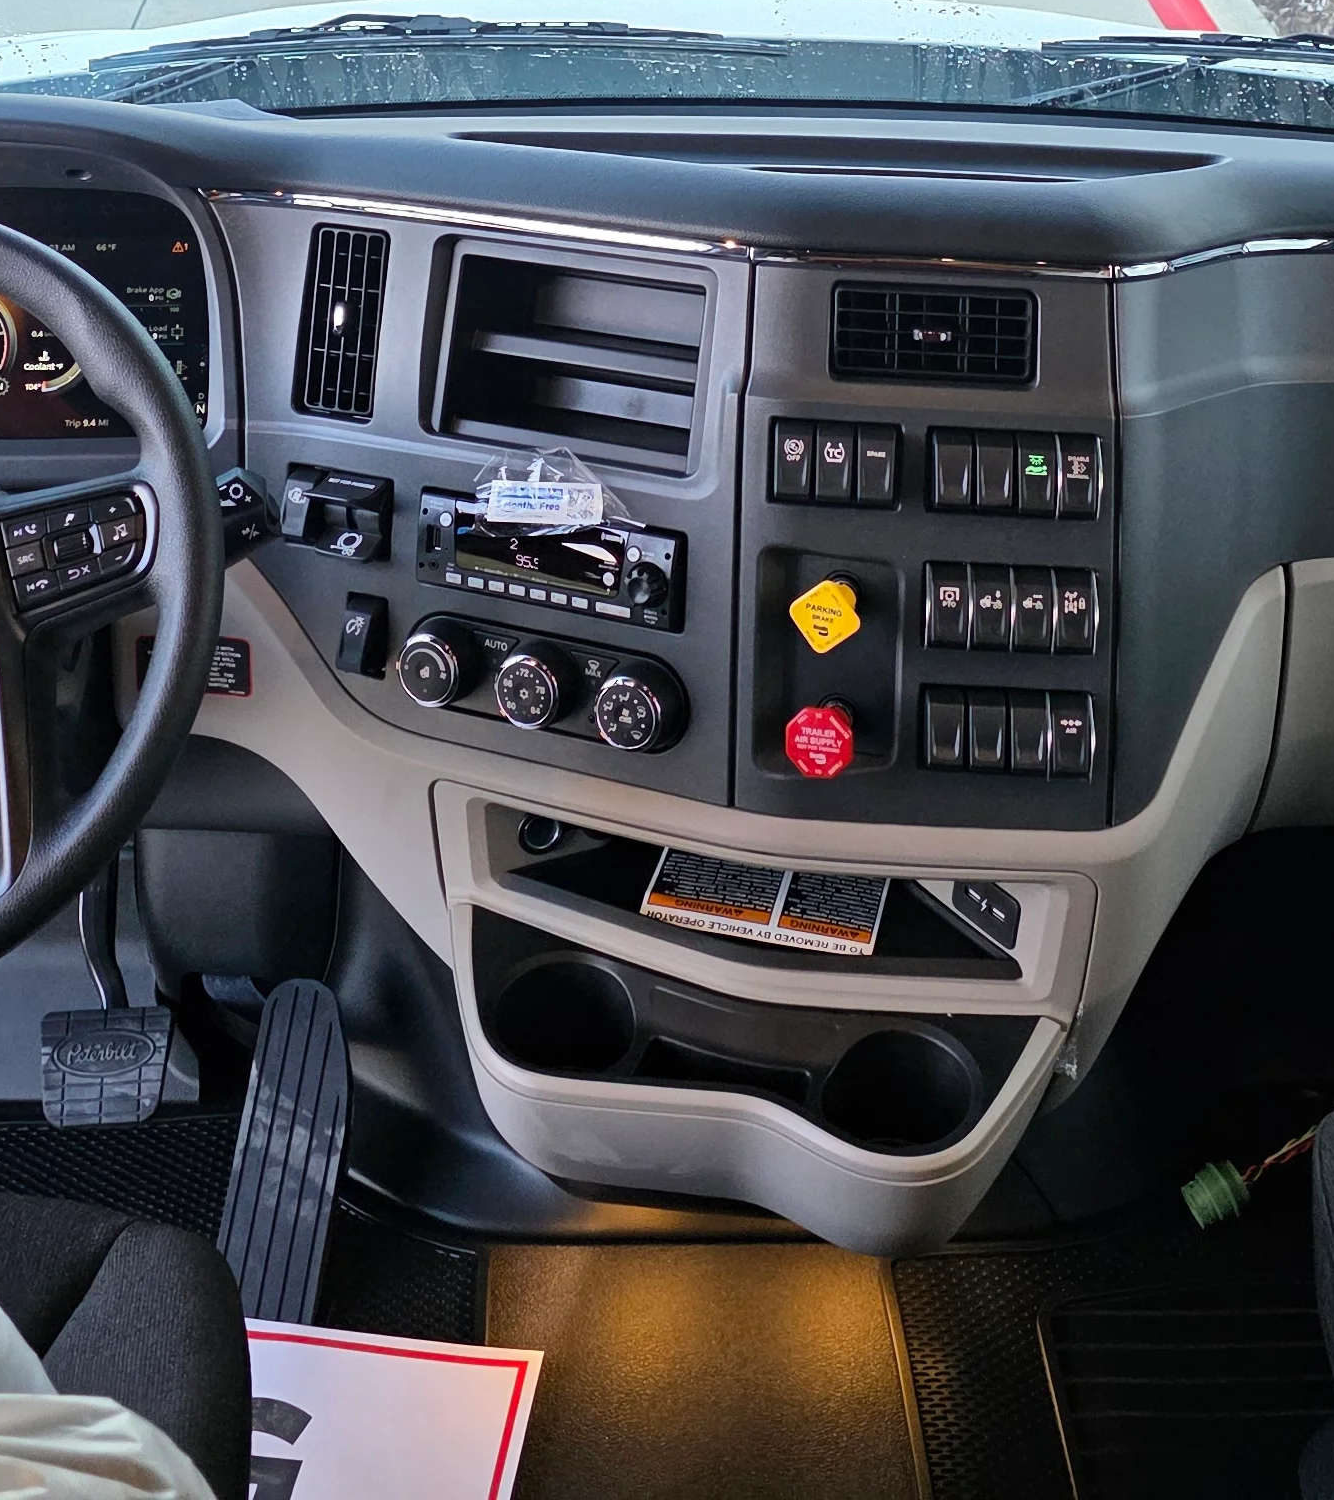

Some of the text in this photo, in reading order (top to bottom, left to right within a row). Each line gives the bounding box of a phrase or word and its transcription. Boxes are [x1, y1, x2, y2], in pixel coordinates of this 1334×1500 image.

[149, 287, 165, 295] App
[149, 324, 168, 332] Load
[23, 363, 55, 371] Coolant
[196, 404, 205, 413] N
[65, 420, 81, 428] Trip
[827, 449, 842, 459] TC
[540, 501, 560, 511] Free
[509, 537, 518, 550] 2
[17, 553, 34, 564] SRC
[806, 602, 842, 617] PARKING
[942, 600, 956, 608] PTO
[812, 613, 834, 623] BRAKE
[484, 638, 508, 651] AUTO
[519, 668, 529, 677] 72
[584, 667, 602, 678] MAX
[801, 727, 836, 738] TRAILER
[794, 735, 843, 748] AIR SUPPLY
[674, 899, 734, 916] WARNING
[646, 910, 864, 955] TO BE REMOVED BY VEHICLE OPERATOR
[790, 919, 850, 938] WARNING
[67, 1042, 144, 1066] Peterbilt
